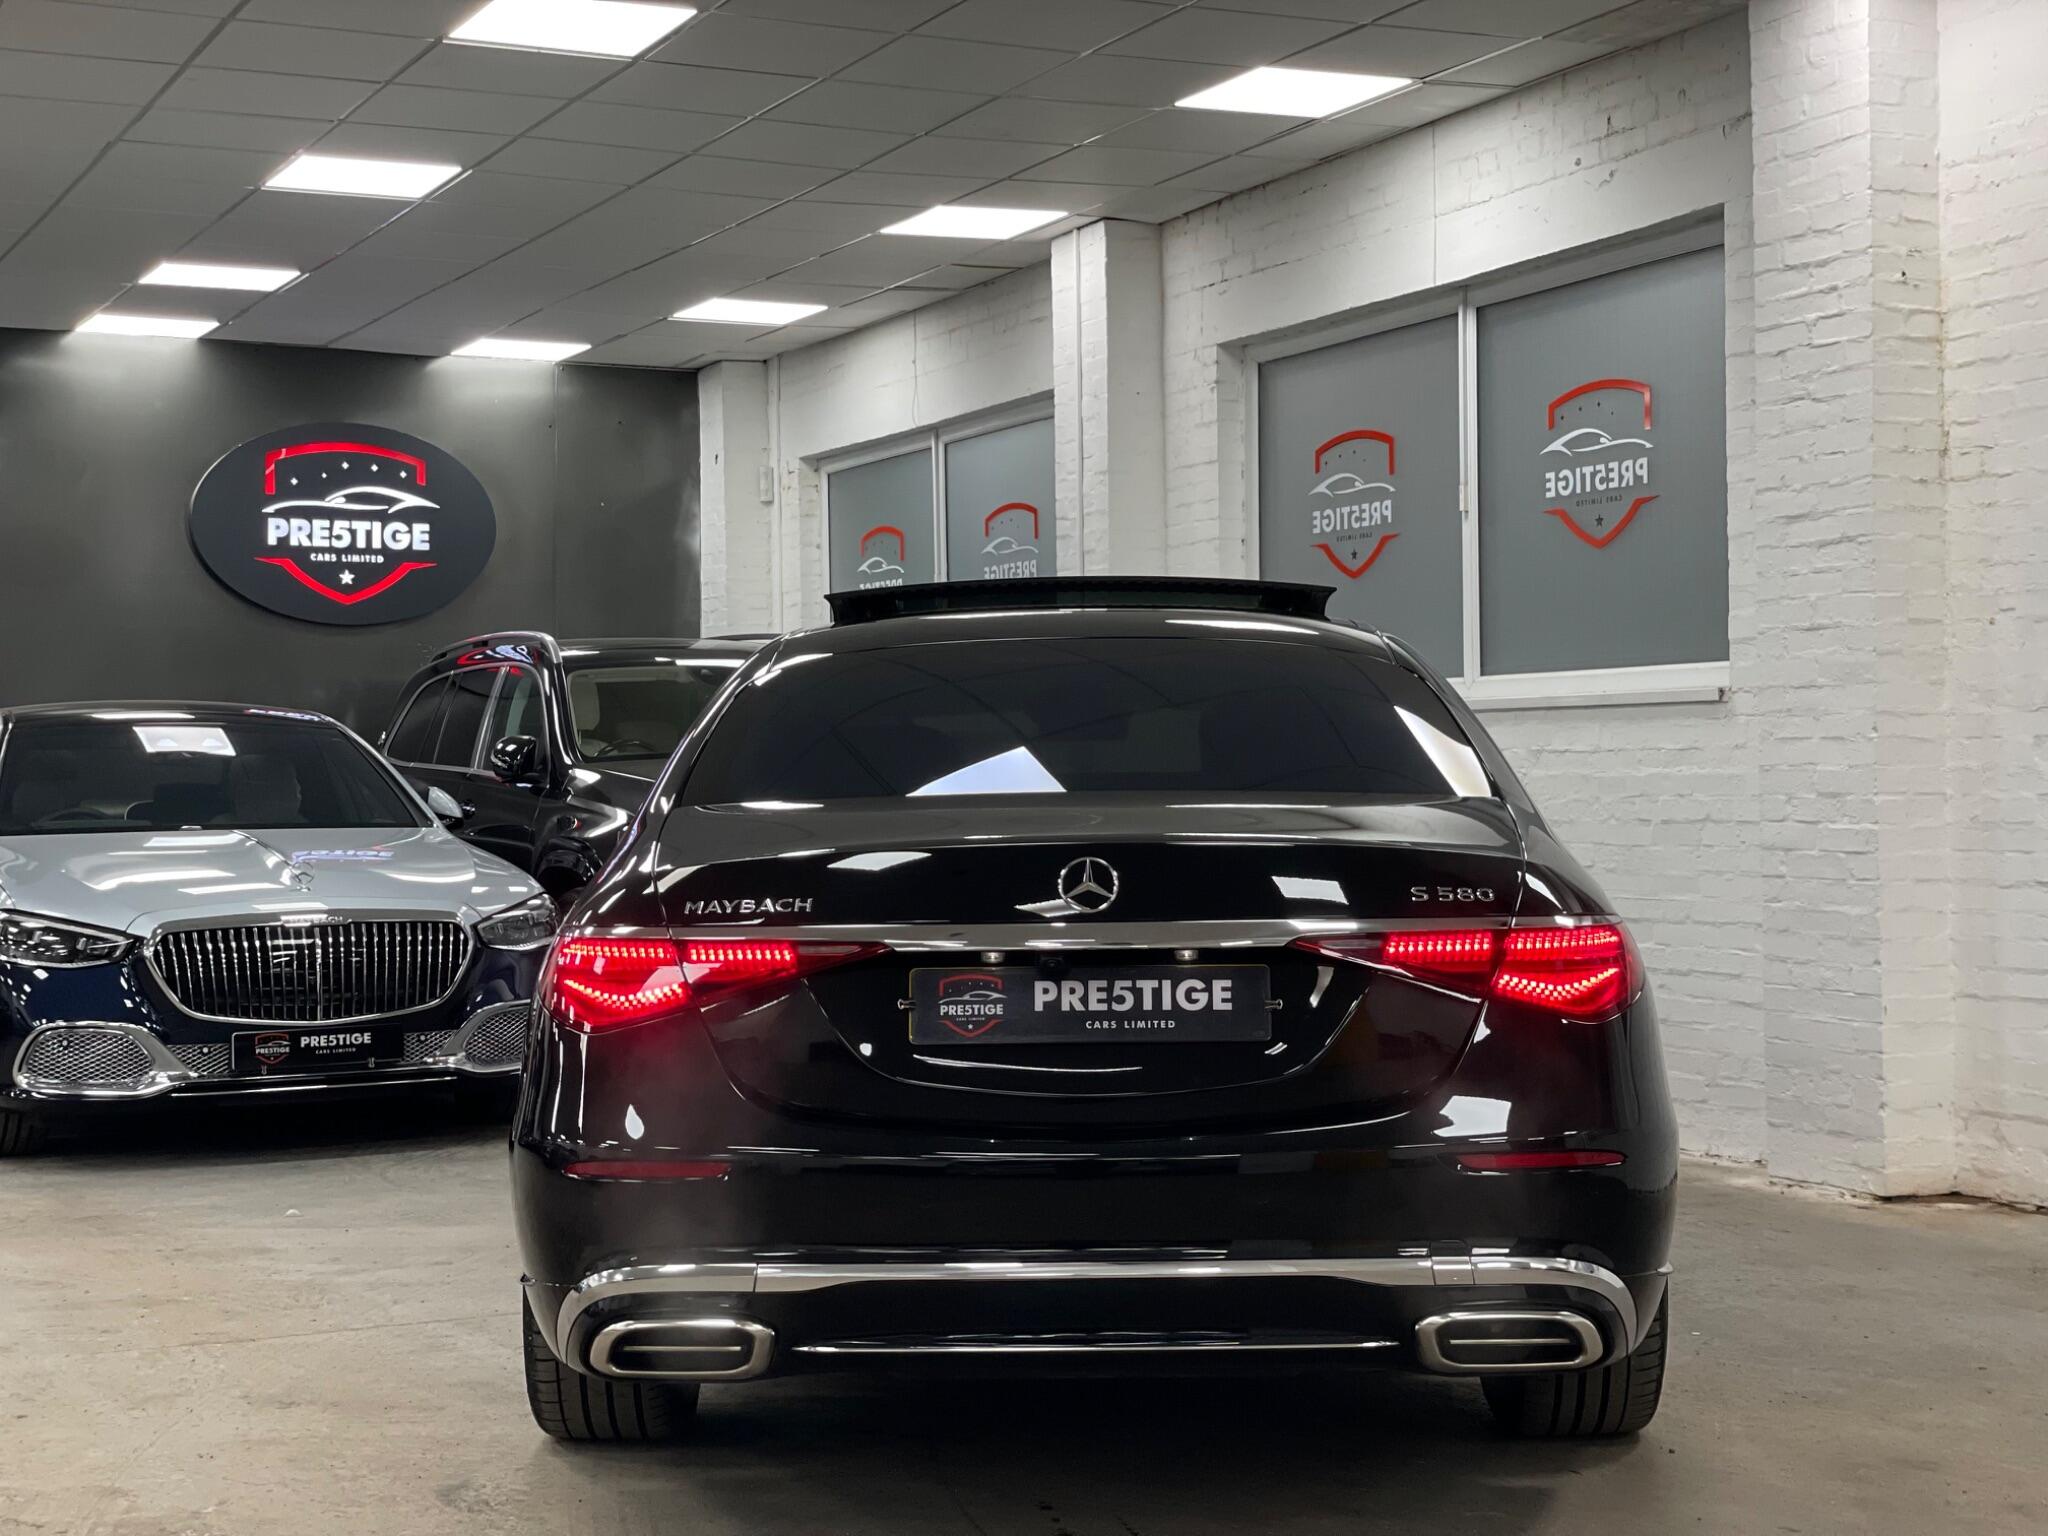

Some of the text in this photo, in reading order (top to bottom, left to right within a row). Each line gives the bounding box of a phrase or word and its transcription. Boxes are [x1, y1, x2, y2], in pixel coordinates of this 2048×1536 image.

[267, 517, 430, 551] PRE5TIGE
[310, 552, 385, 564] CARS LIMITED
[1410, 886, 1495, 901] S 580
[684, 898, 813, 914] MAYBACH
[1034, 979, 1233, 1012] PRE5TIGE
[940, 1004, 1004, 1016] PRE5TIGE
[1085, 1020, 1176, 1029] CARS LIMITED
[300, 1032, 372, 1048] PRE5TIGE
